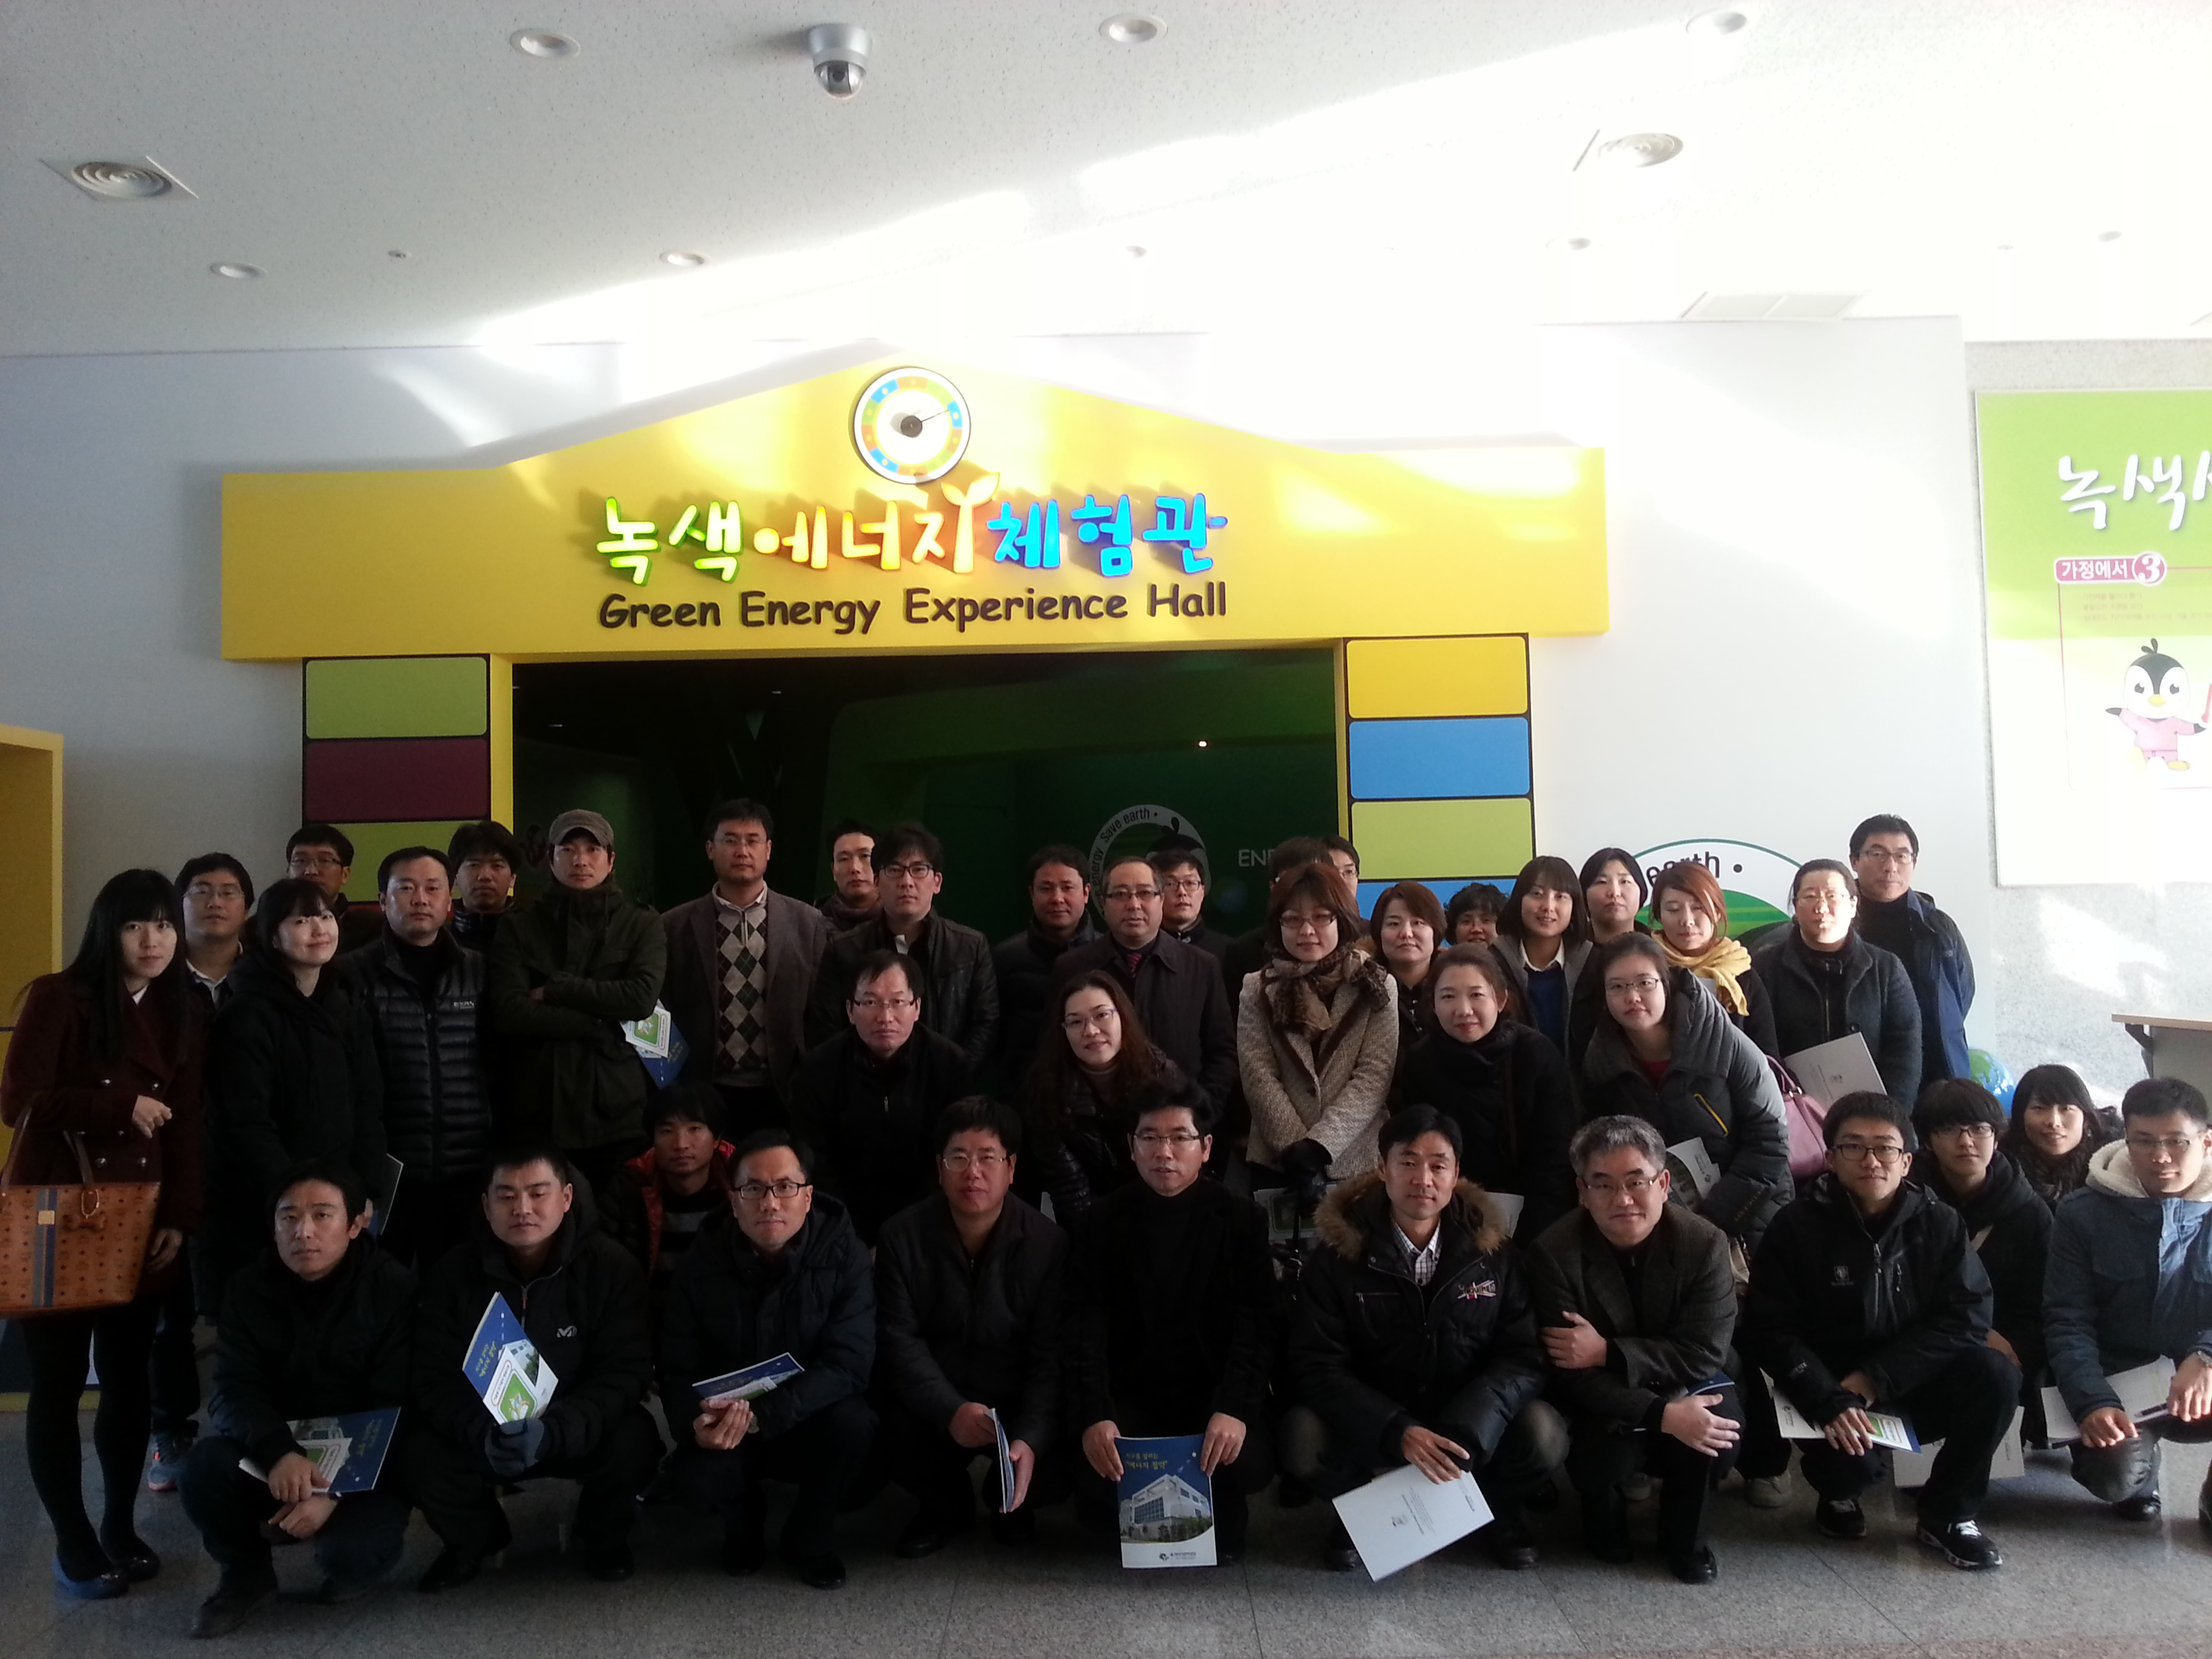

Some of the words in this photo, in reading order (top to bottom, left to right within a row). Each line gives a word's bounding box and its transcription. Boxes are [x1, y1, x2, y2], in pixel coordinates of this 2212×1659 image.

[2062, 560, 2127, 580] 가정에서
[2137, 555, 2162, 584] 3
[599, 593, 721, 629] Green
[740, 590, 881, 635] Energy
[905, 583, 1128, 633] Experience
[1149, 581, 1226, 617] Hall
[1100, 819, 1122, 842] Save
[1123, 807, 1150, 823] earth
